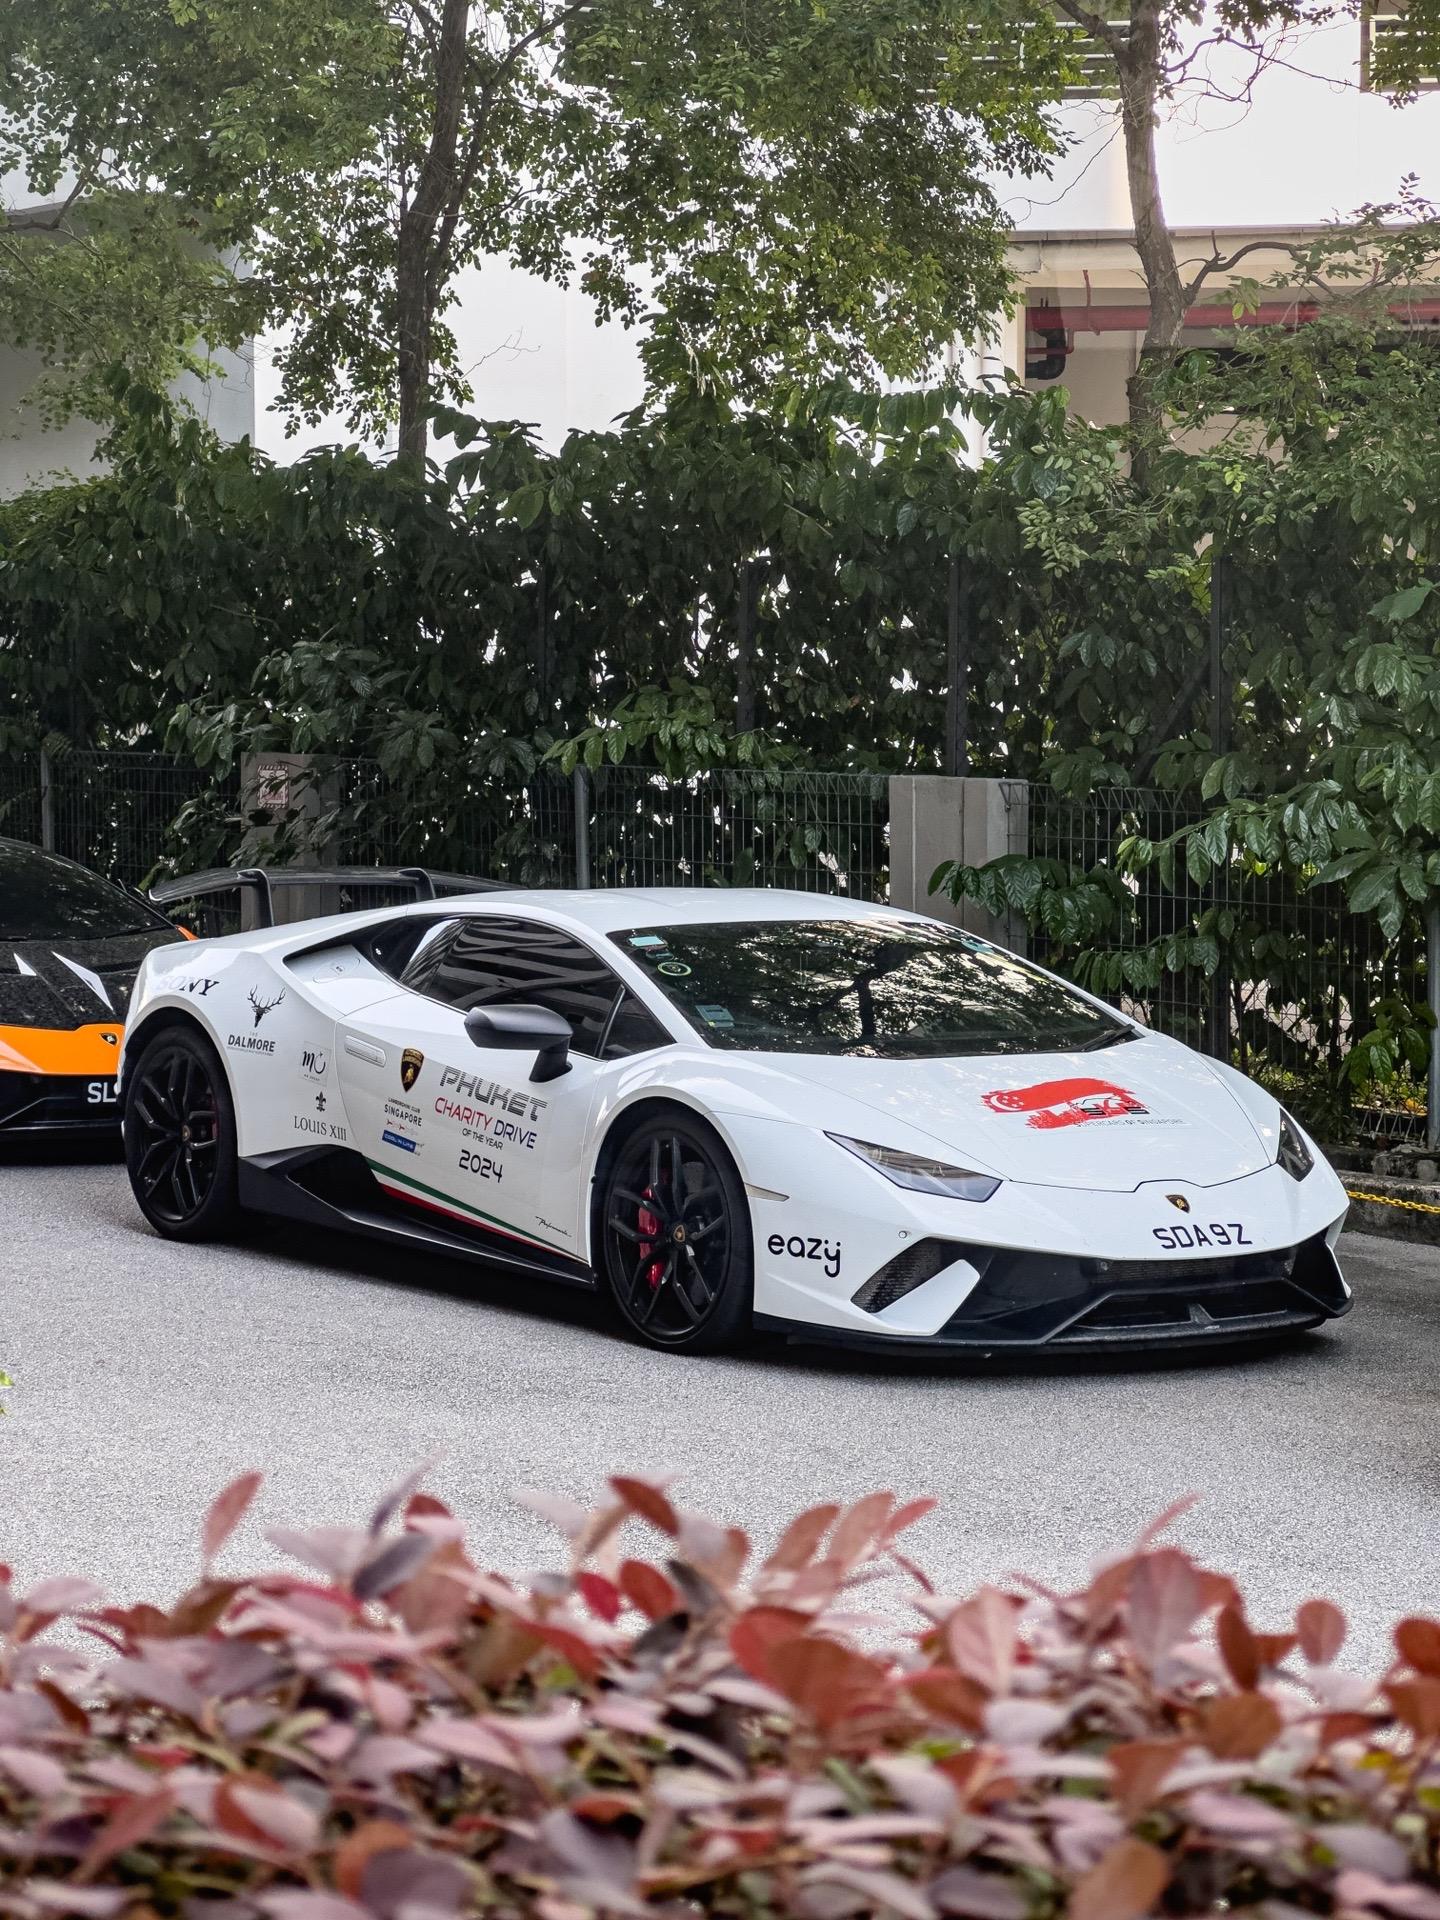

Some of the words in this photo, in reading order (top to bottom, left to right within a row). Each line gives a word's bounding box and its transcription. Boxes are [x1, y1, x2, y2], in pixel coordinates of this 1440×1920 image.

[227, 1034, 276, 1053] DALMORE
[87, 1081, 117, 1103] SL
[440, 1065, 548, 1122] PHUKET
[384, 1103, 422, 1127] SINGAPORE
[434, 1096, 493, 1131] CHARITY
[494, 1119, 537, 1150] DRIVE
[294, 1115, 327, 1136] LOUIS
[329, 1124, 347, 1142] XIII
[462, 1127, 472, 1137] OF
[473, 1131, 485, 1144] THE
[485, 1136, 504, 1151] YEAR
[458, 1148, 503, 1183] 2024
[1152, 1224, 1253, 1249] SDA9Z
